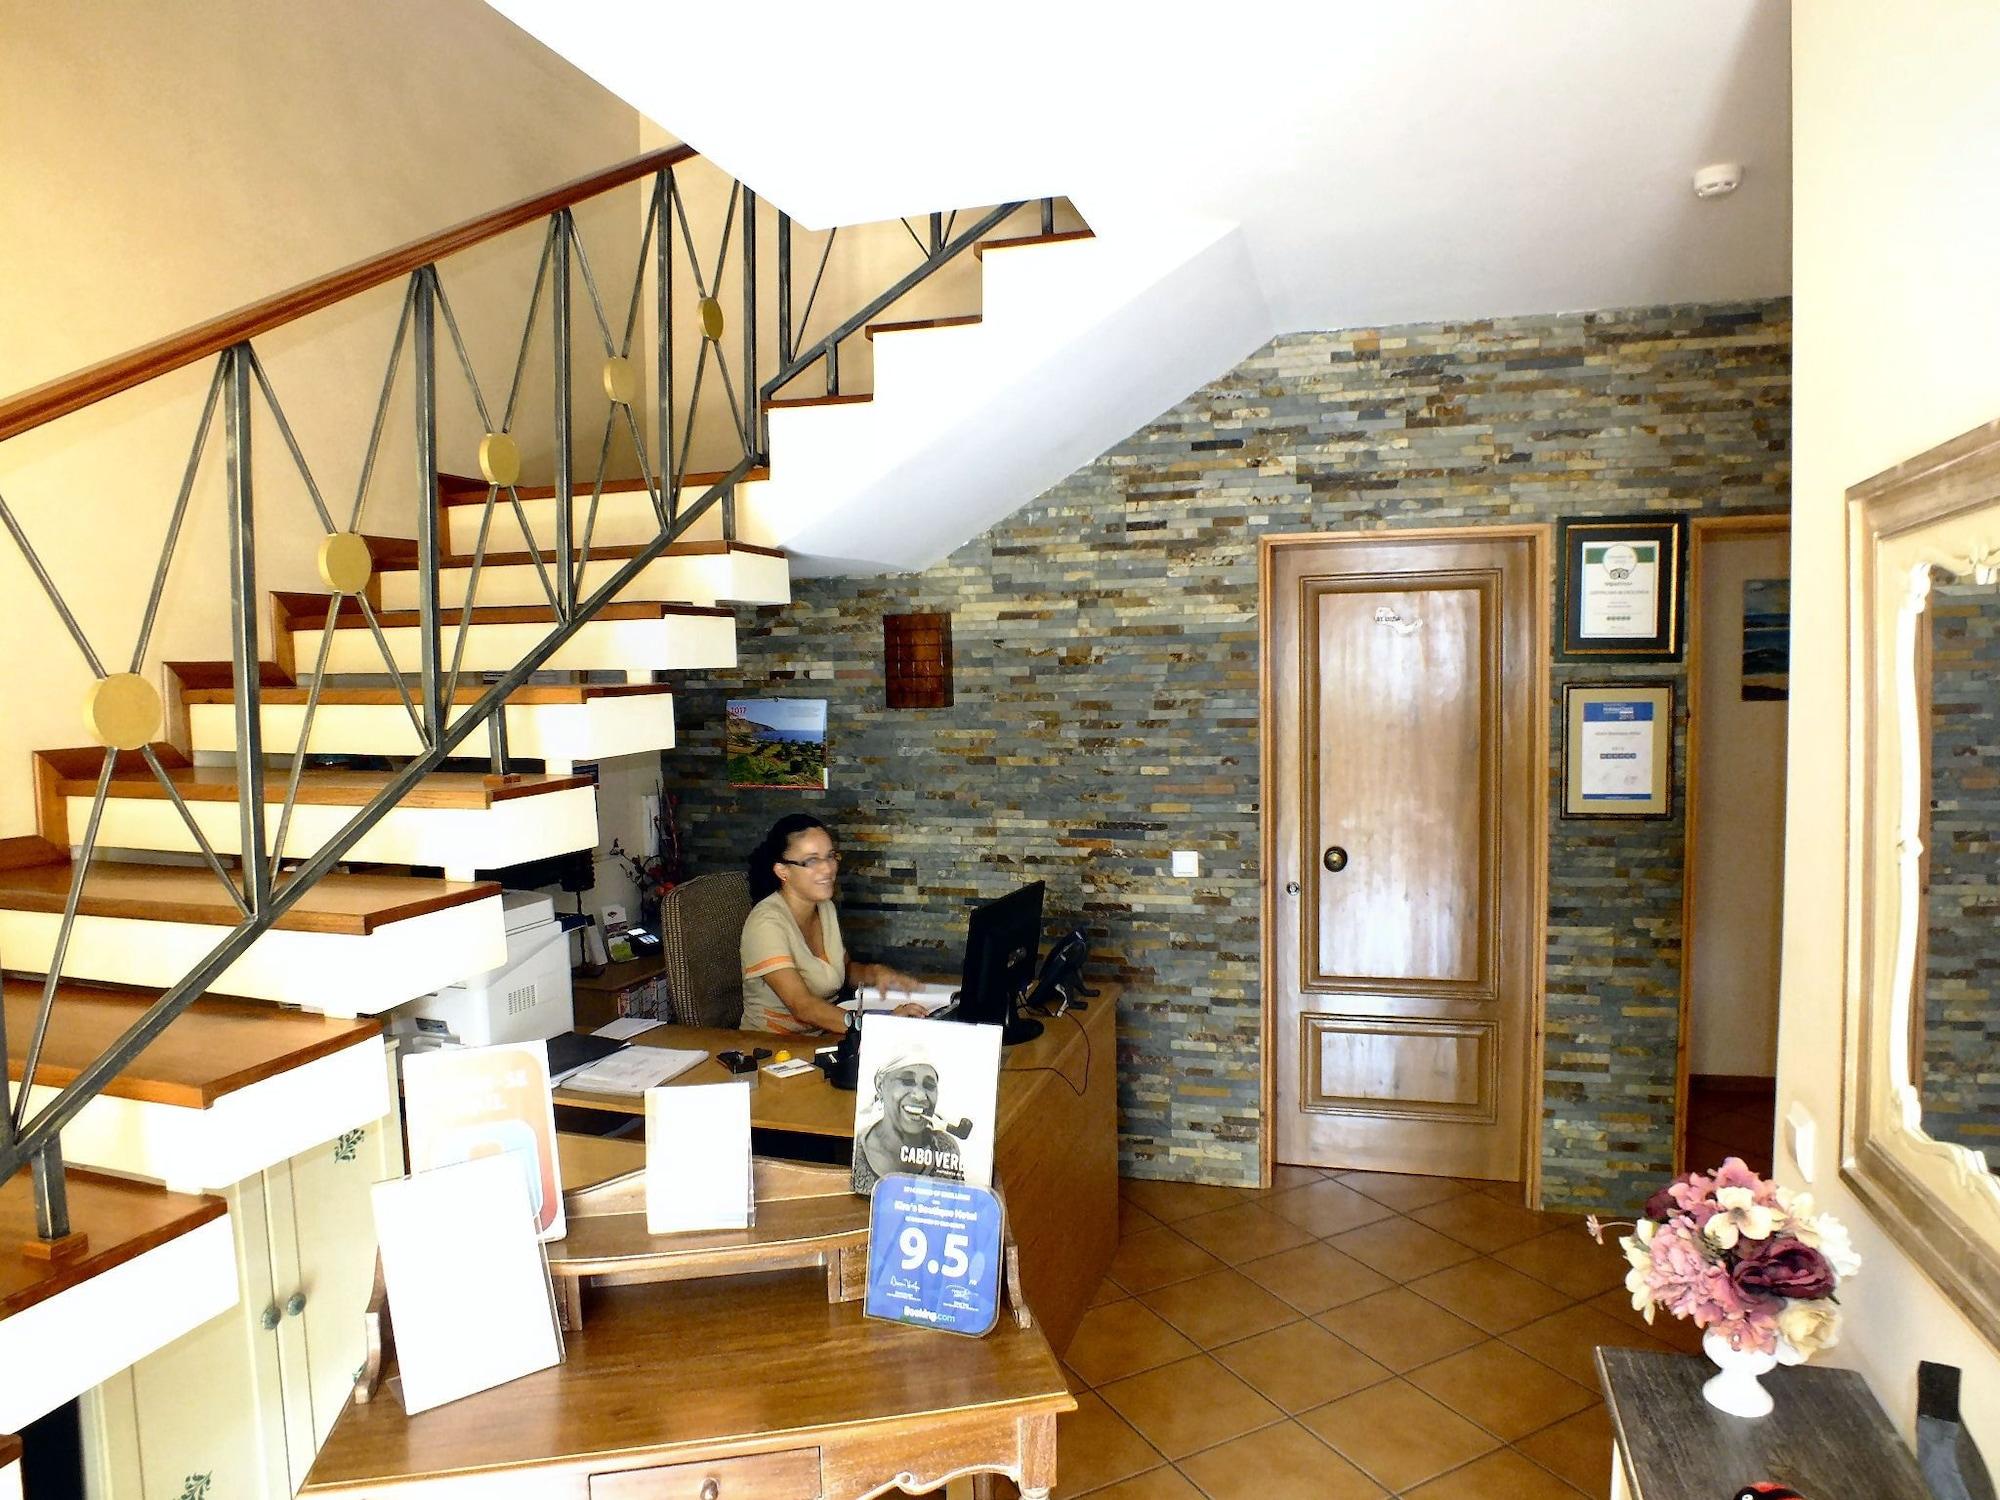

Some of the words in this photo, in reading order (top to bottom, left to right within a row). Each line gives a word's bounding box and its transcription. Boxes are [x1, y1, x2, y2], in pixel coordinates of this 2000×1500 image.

[900, 1145, 933, 1166] CABO
[899, 1227, 969, 1278] 9.5
[903, 1305, 956, 1323] Booking.com
